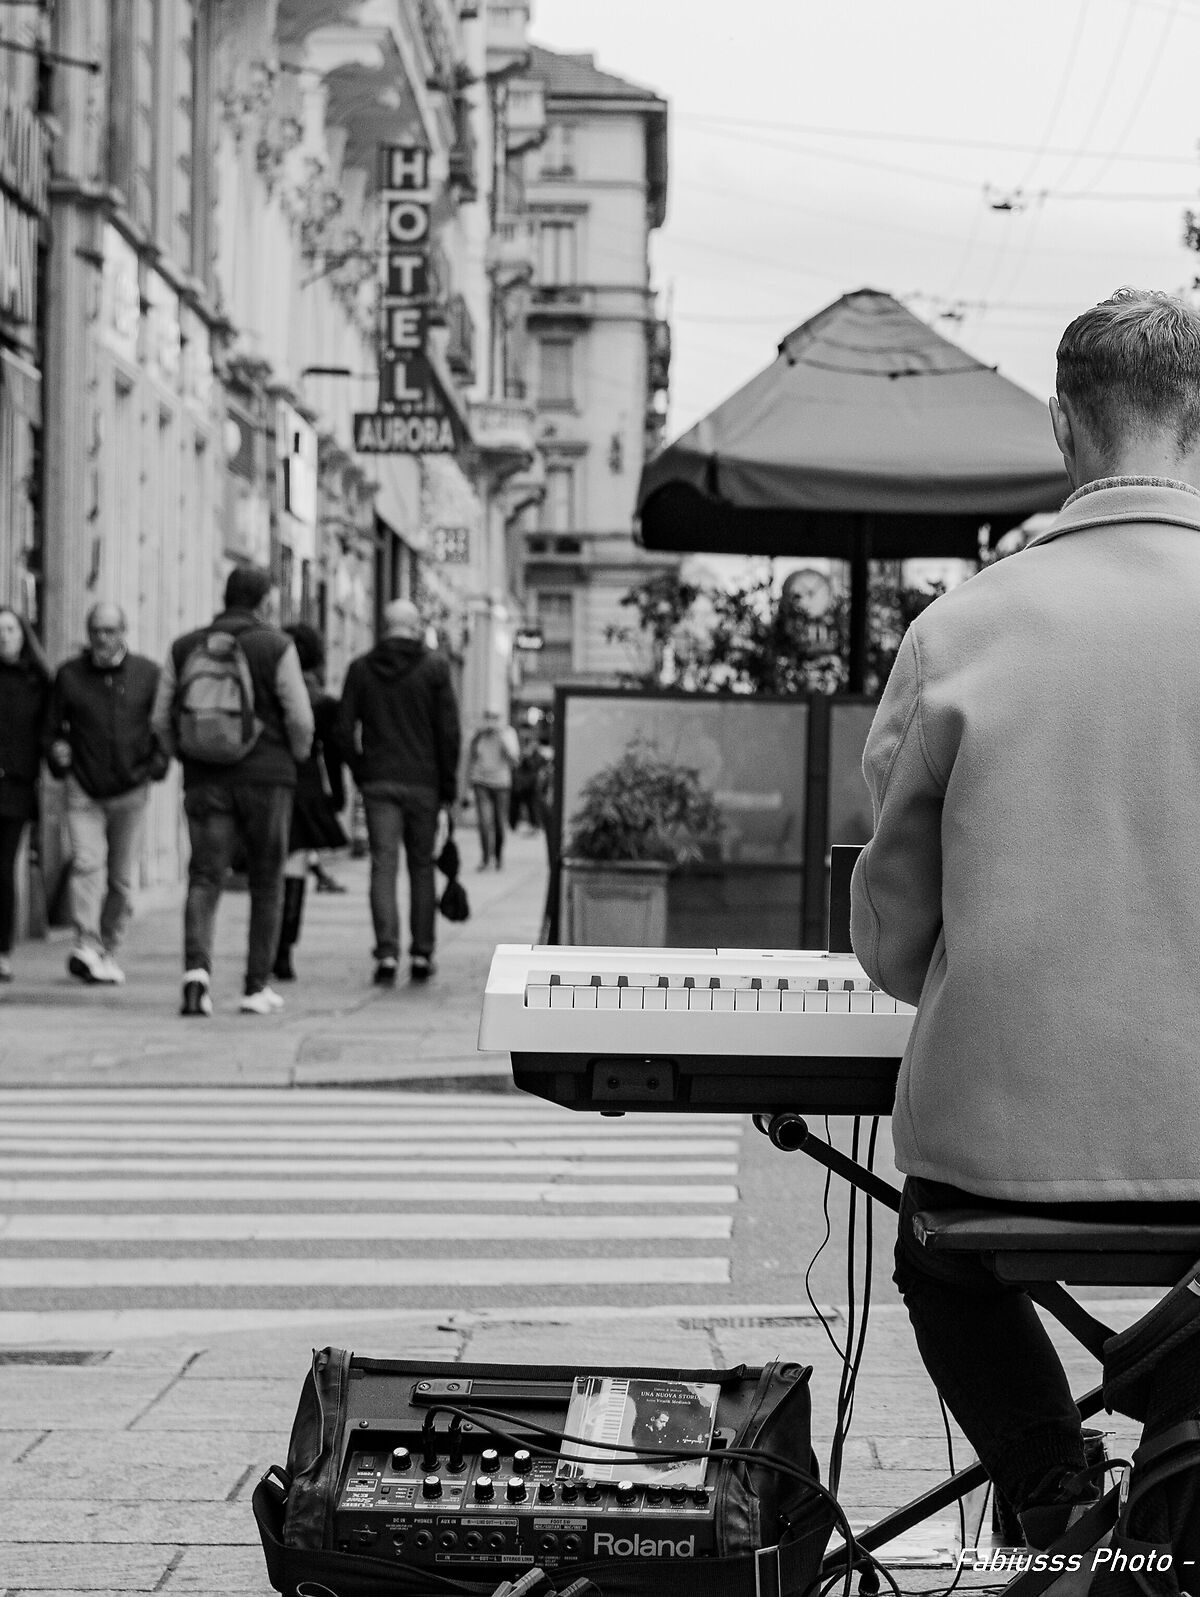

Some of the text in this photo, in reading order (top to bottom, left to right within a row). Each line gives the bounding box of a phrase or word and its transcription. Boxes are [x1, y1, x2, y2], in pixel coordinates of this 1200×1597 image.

[389, 150, 428, 401] HOTEL
[358, 417, 455, 451] AURORA
[593, 1532, 695, 1557] Roland
